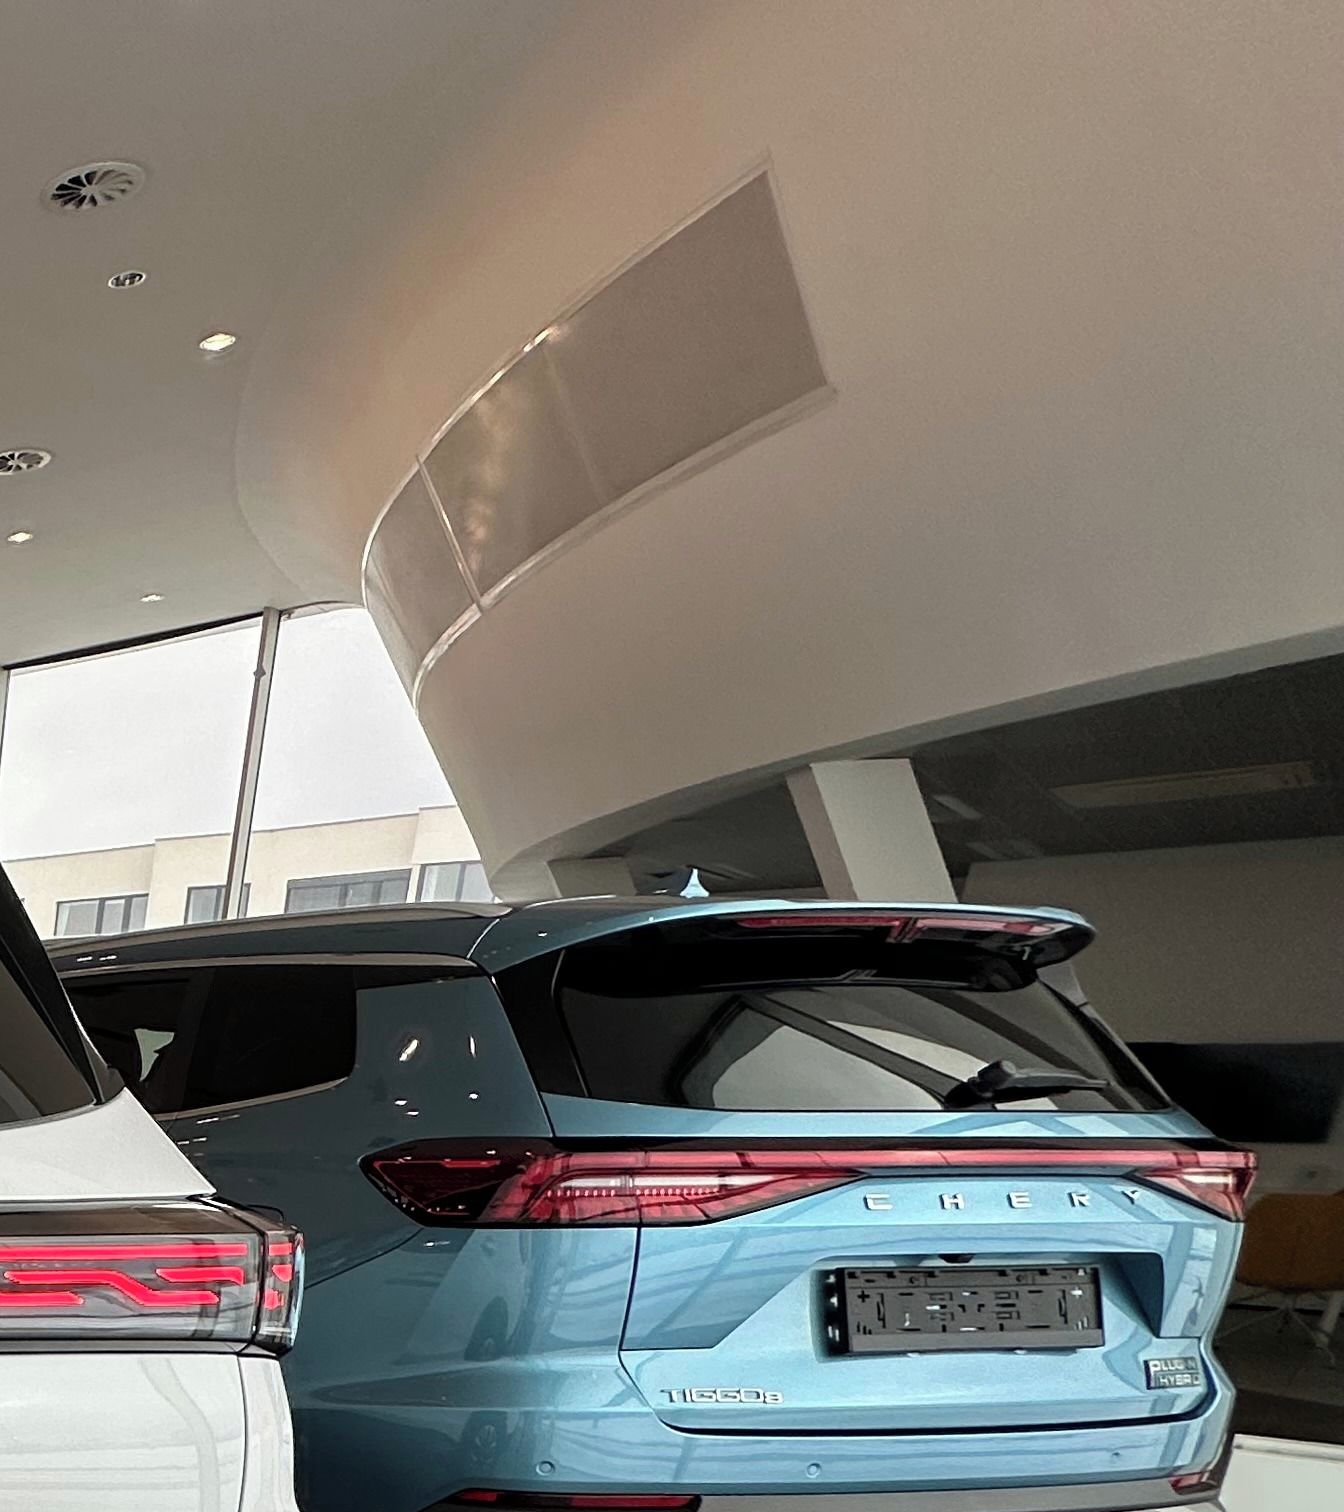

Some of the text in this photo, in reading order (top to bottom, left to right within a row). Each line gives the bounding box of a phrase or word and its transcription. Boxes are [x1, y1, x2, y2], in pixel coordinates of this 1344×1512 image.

[864, 1190, 1141, 1211] CHERY
[1160, 1374, 1201, 1386] HYBRD
[660, 1388, 763, 1403] TIGGO
